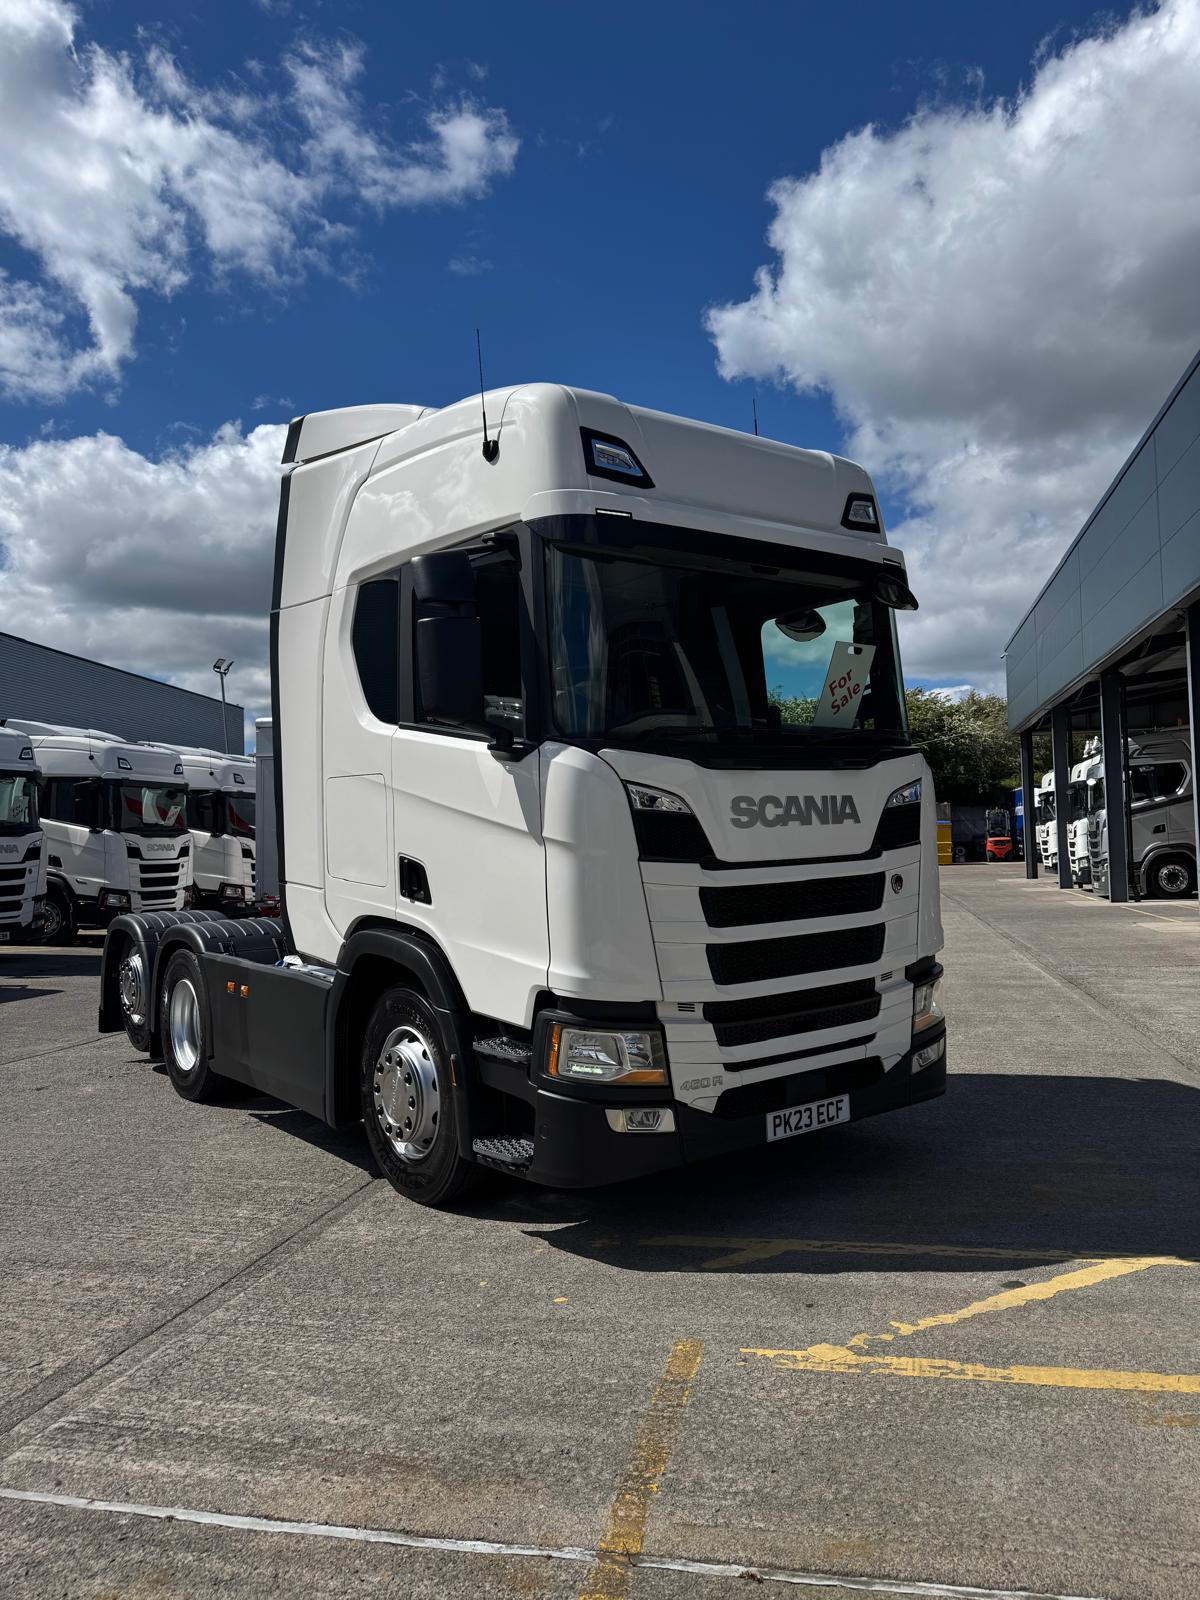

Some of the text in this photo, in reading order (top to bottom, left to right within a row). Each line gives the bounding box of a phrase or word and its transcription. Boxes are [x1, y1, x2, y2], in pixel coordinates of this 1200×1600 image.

[828, 669, 853, 698] For
[830, 682, 861, 715] Sale
[730, 795, 861, 829] SCANIA
[773, 1098, 844, 1137] PK23 ECF
